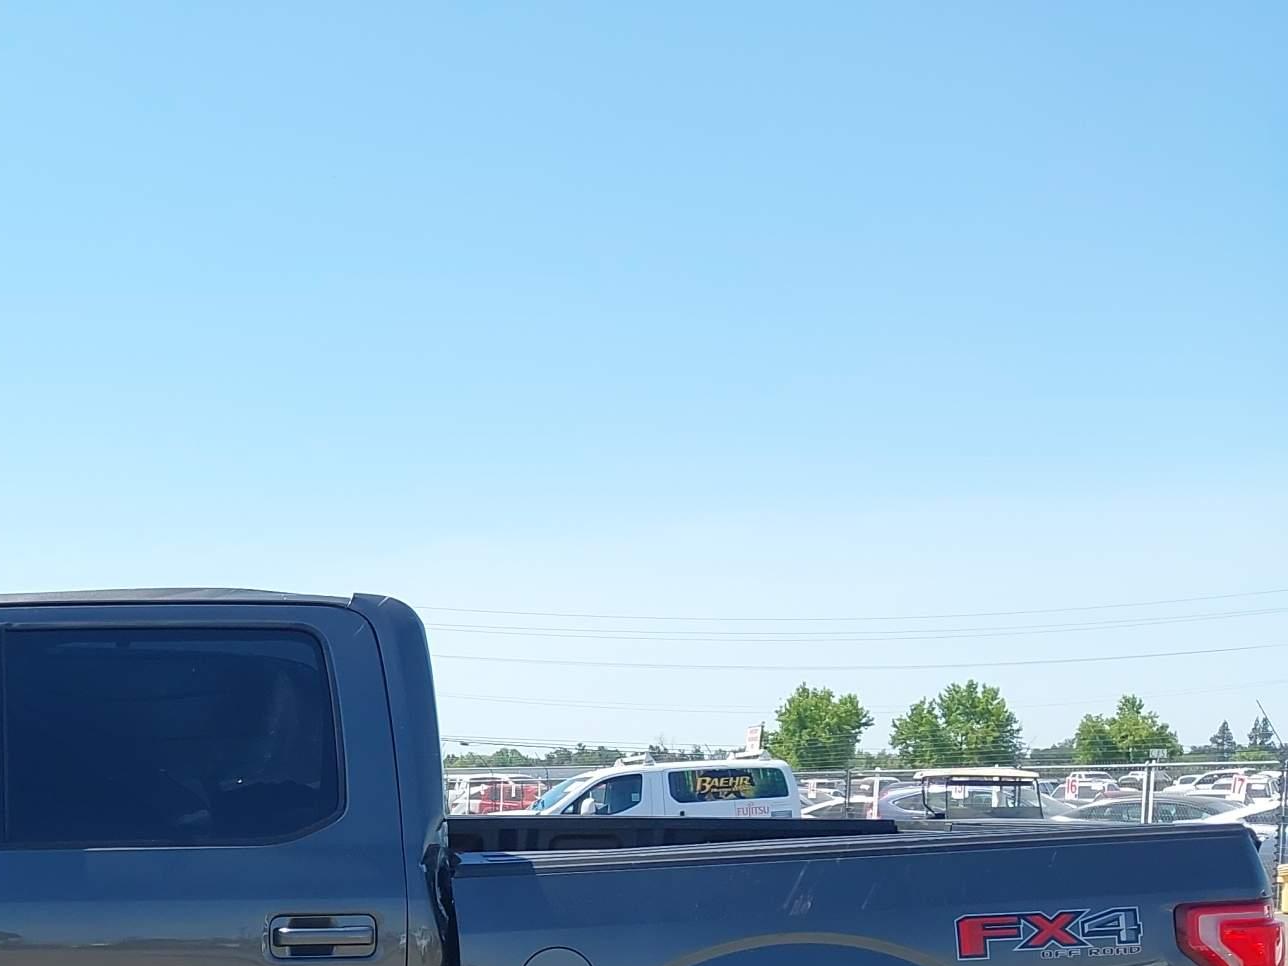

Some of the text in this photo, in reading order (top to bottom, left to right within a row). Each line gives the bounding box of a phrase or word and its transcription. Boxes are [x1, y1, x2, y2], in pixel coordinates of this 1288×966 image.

[696, 776, 751, 794] BAEHR
[1066, 778, 1078, 794] 16
[1233, 776, 1246, 793] 17
[737, 806, 770, 816] FUJITSU
[954, 906, 1144, 960] FX4
[1040, 945, 1142, 960] OFF ROAD
